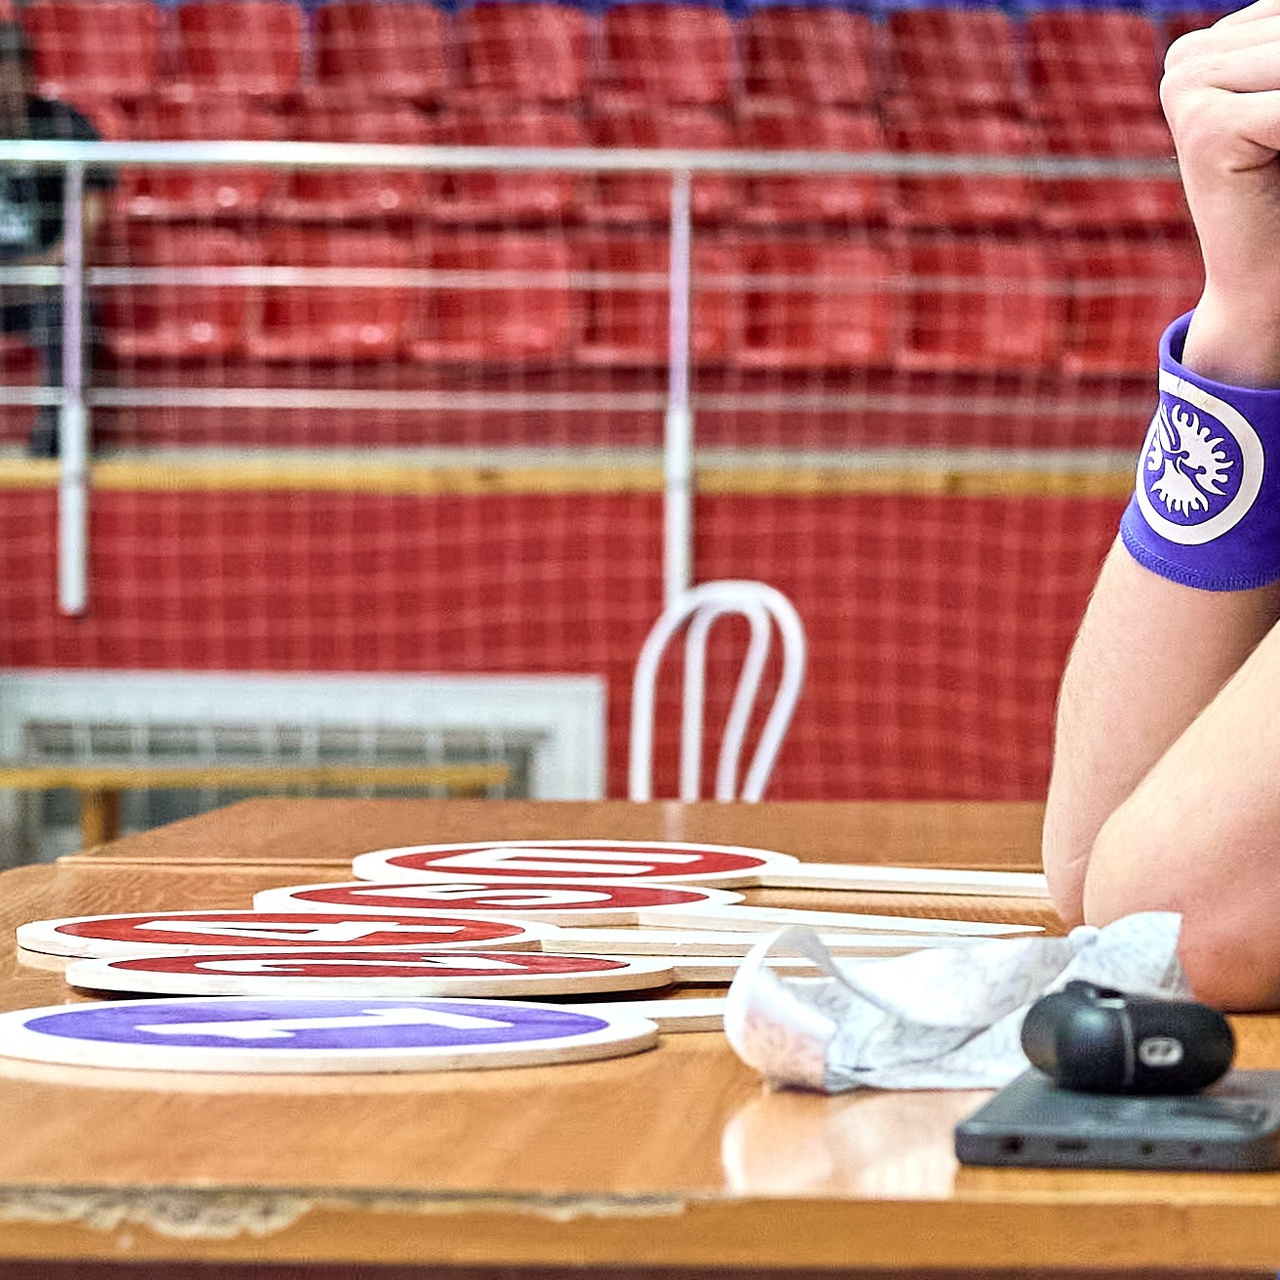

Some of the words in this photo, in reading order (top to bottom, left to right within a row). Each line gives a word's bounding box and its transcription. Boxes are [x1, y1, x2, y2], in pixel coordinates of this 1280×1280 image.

[350, 884, 612, 905] 5
[134, 920, 466, 941] 4
[193, 956, 530, 971] 2
[134, 1008, 514, 1039] 1
